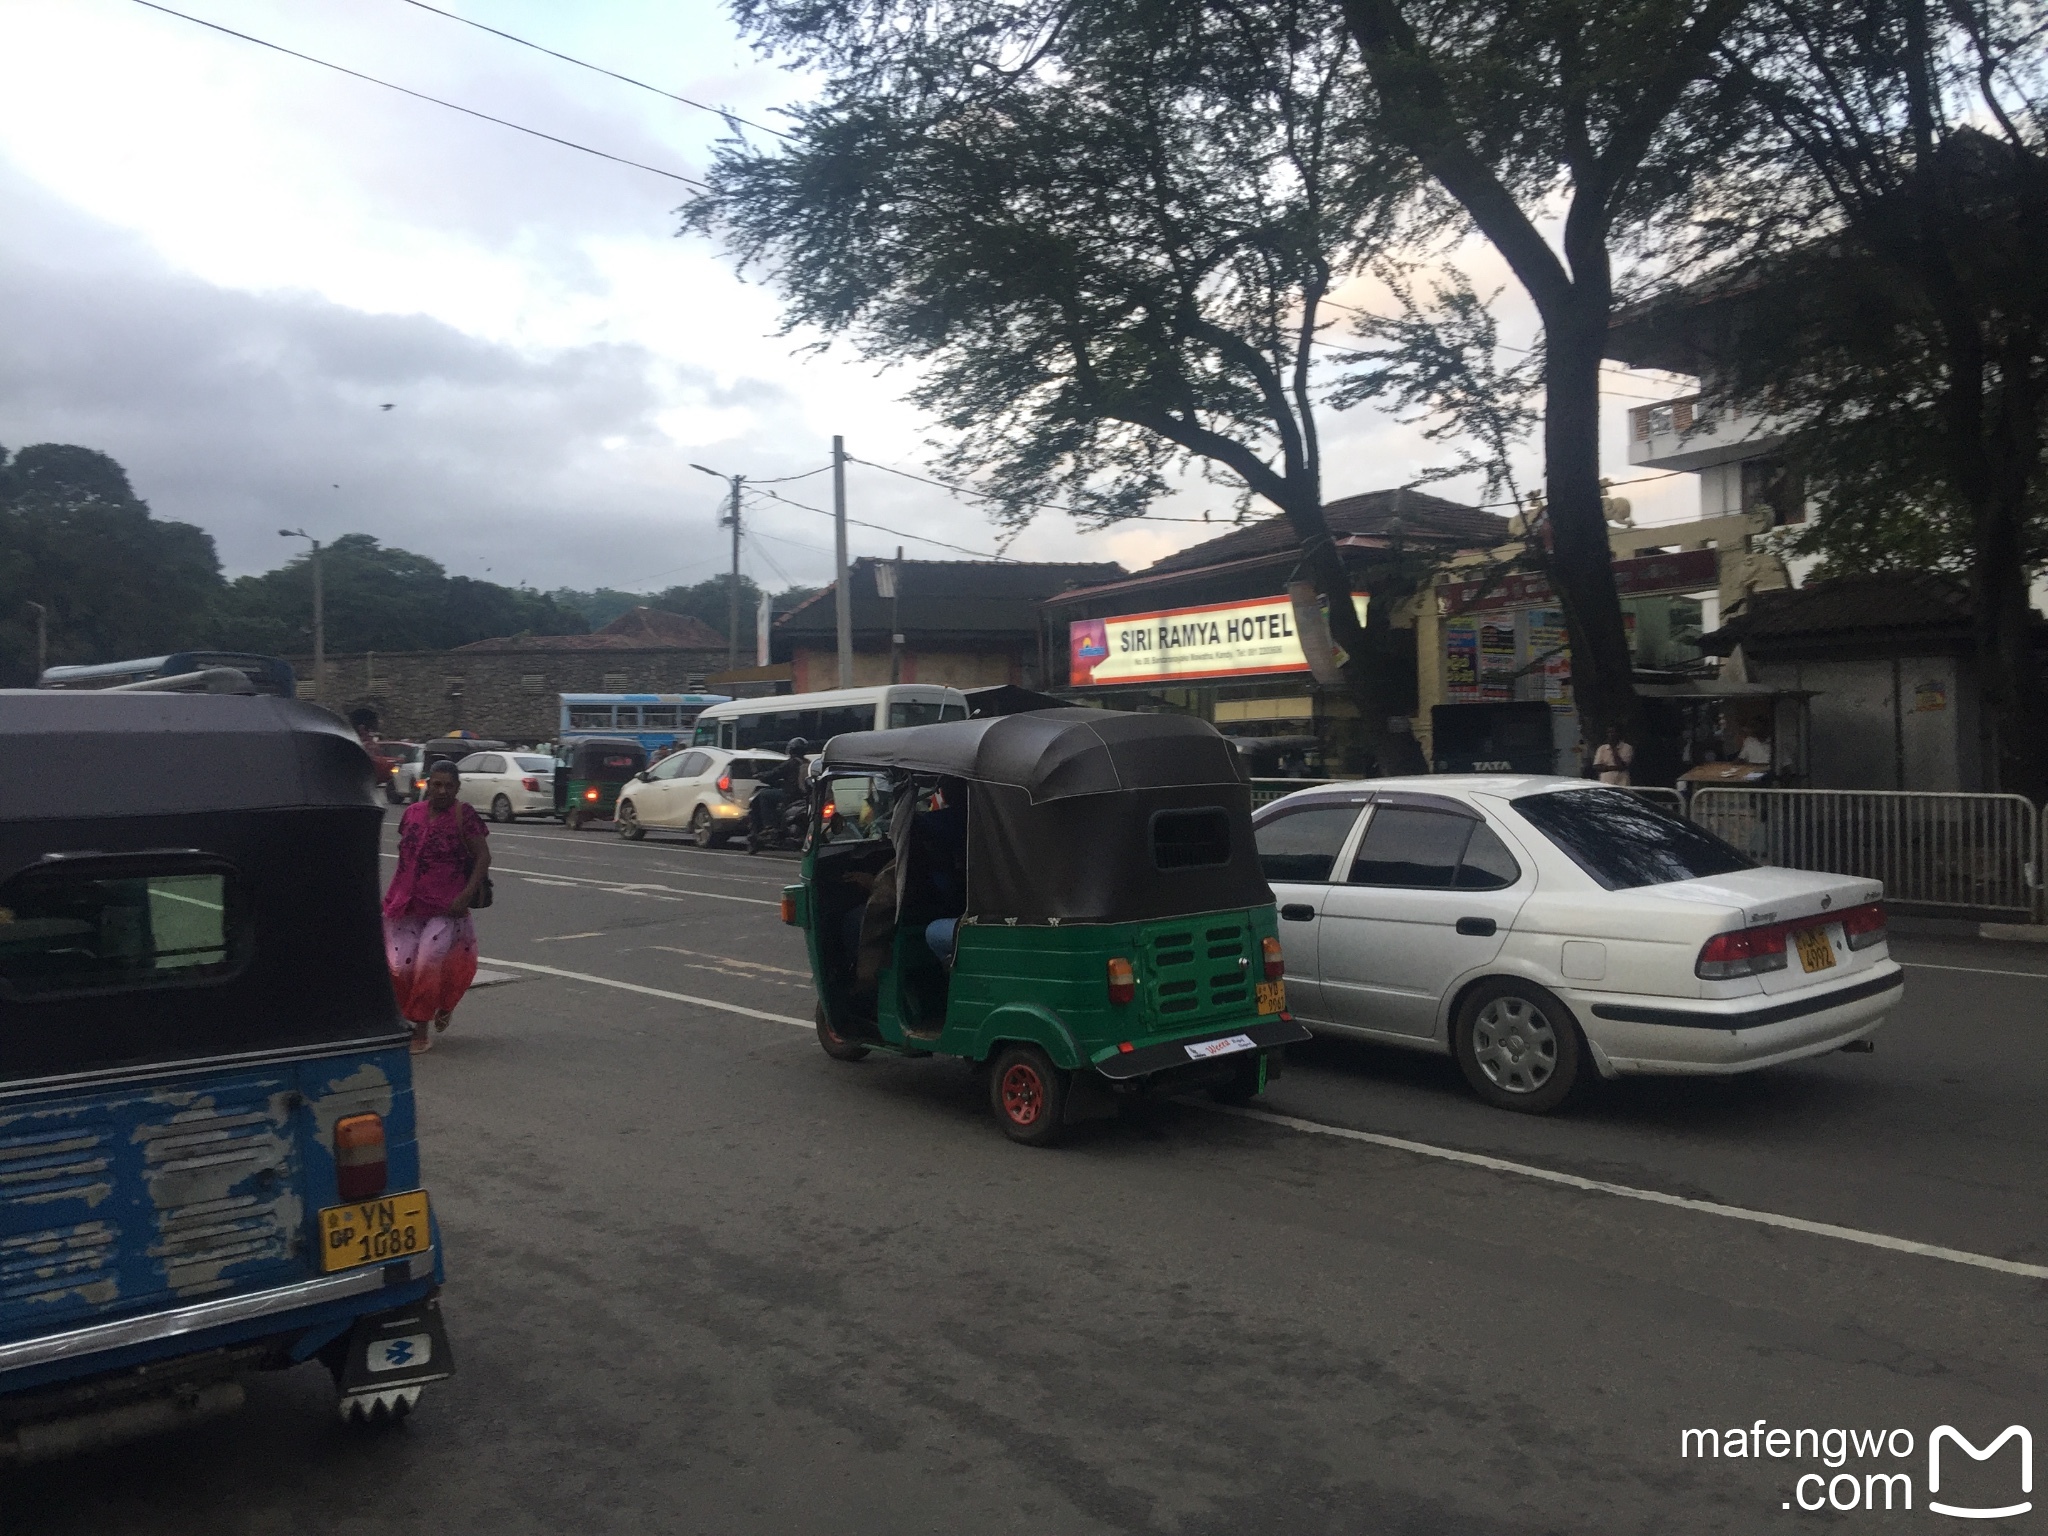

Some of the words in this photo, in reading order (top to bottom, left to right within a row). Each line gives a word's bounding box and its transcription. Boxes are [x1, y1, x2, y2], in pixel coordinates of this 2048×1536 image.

[1120, 628, 1151, 652] SIRI
[1158, 621, 1221, 650] RAMYA
[1227, 613, 1293, 643] HOTEL
[1471, 761, 1512, 771] TATA
[360, 1200, 394, 1230] YN
[358, 1225, 416, 1261] 1088
